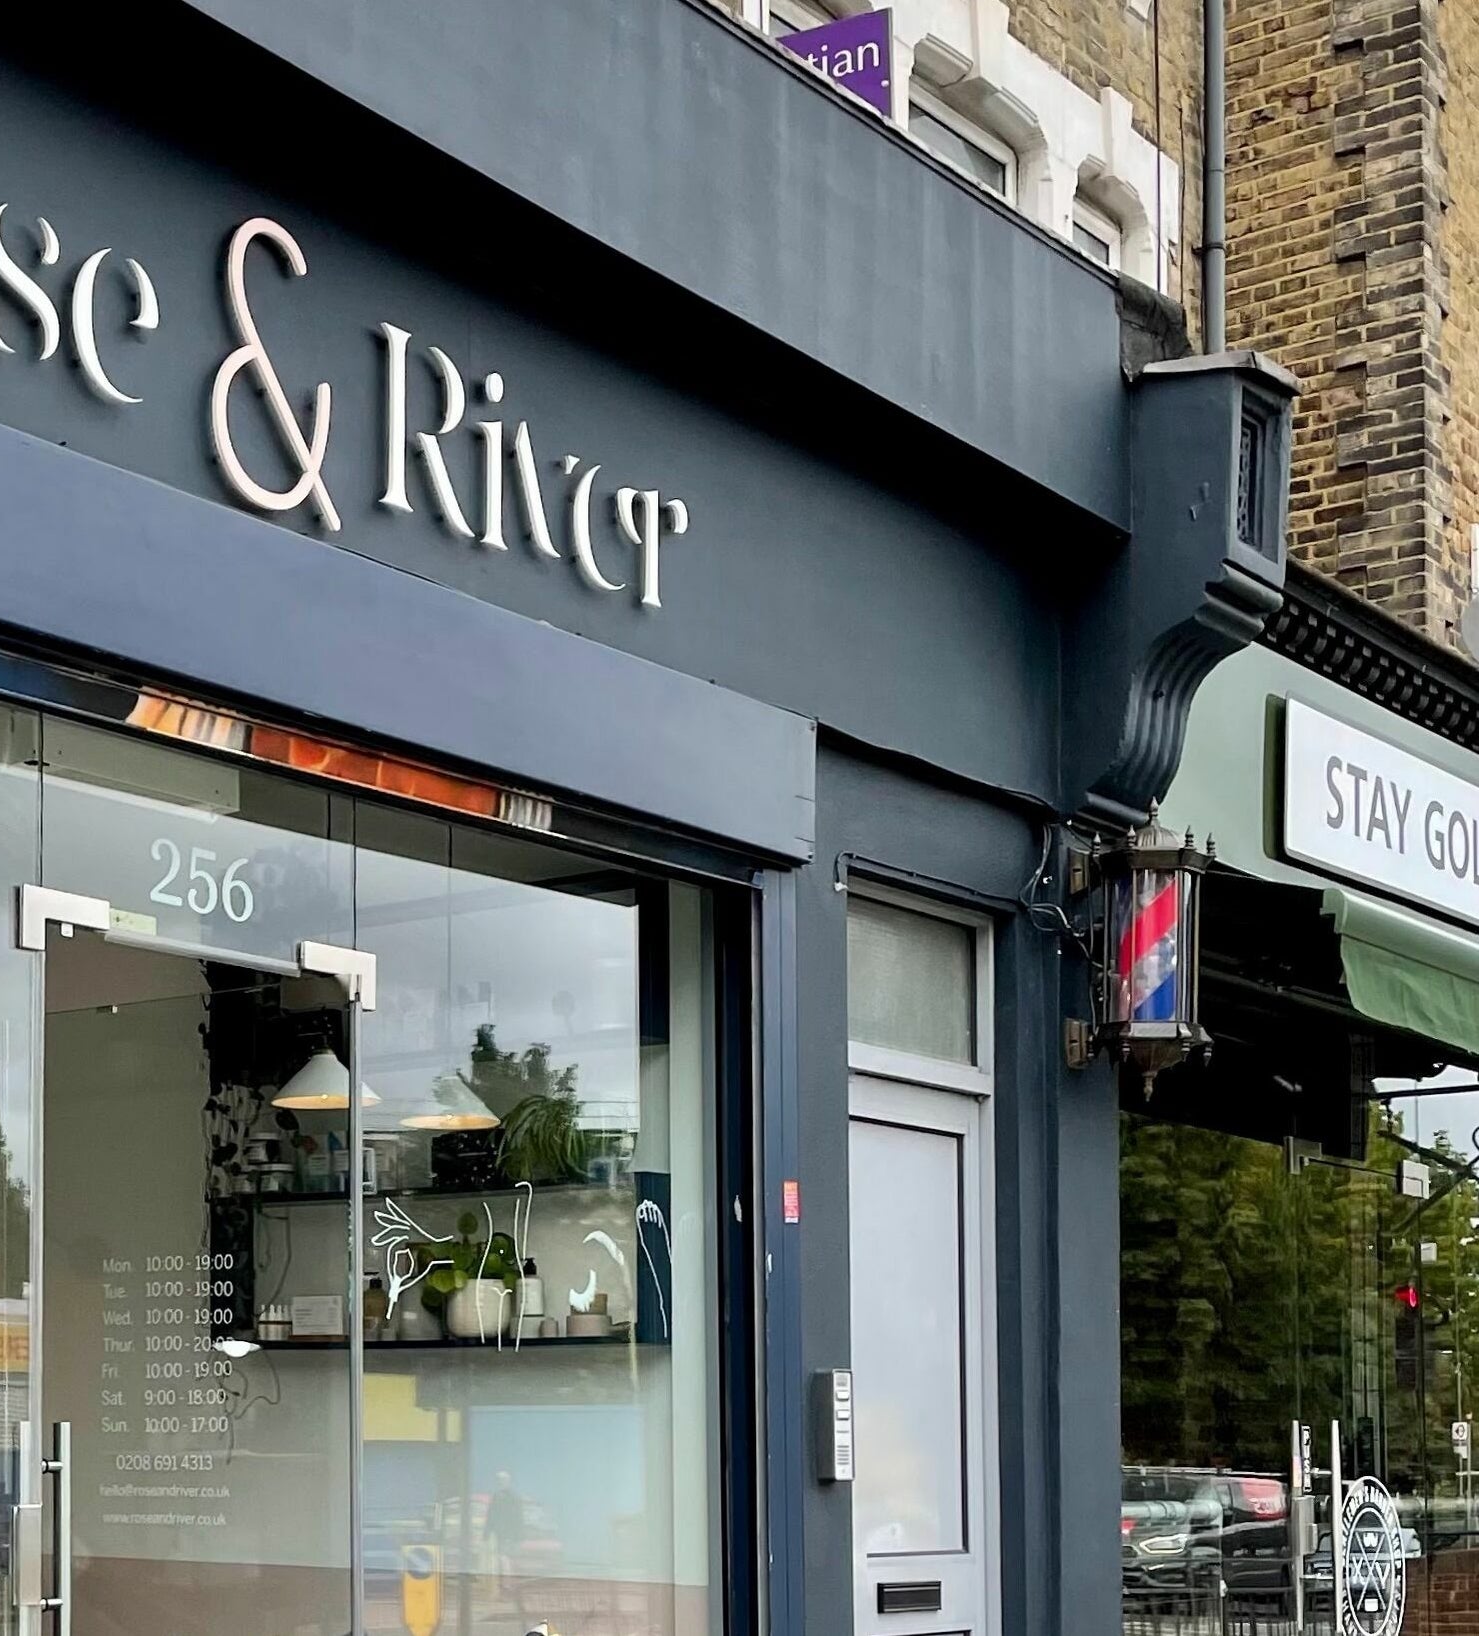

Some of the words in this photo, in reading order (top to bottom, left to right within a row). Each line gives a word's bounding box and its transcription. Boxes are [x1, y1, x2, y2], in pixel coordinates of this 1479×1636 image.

[210, 217, 343, 532] &
[378, 321, 690, 608] River
[1326, 755, 1412, 855] STAY
[150, 838, 254, 922] 256
[145, 1256, 184, 1272] 10:00
[195, 1254, 234, 1271] 19:00
[145, 1281, 184, 1297] 10:00
[194, 1281, 234, 1297] 19:00
[145, 1308, 183, 1325] 10:00
[194, 1308, 233, 1325] 19:00
[145, 1335, 183, 1352] 10:00
[145, 1362, 183, 1378] 10:00
[194, 1360, 233, 1377] 19:00
[144, 1389, 176, 1406] 9:00
[187, 1388, 226, 1405] 18:00
[145, 1416, 180, 1433] 10:00
[192, 1416, 229, 1433] 17:00
[116, 1454, 152, 1471] 0208
[153, 1455, 178, 1471] 691
[180, 1454, 213, 1471] 4313
